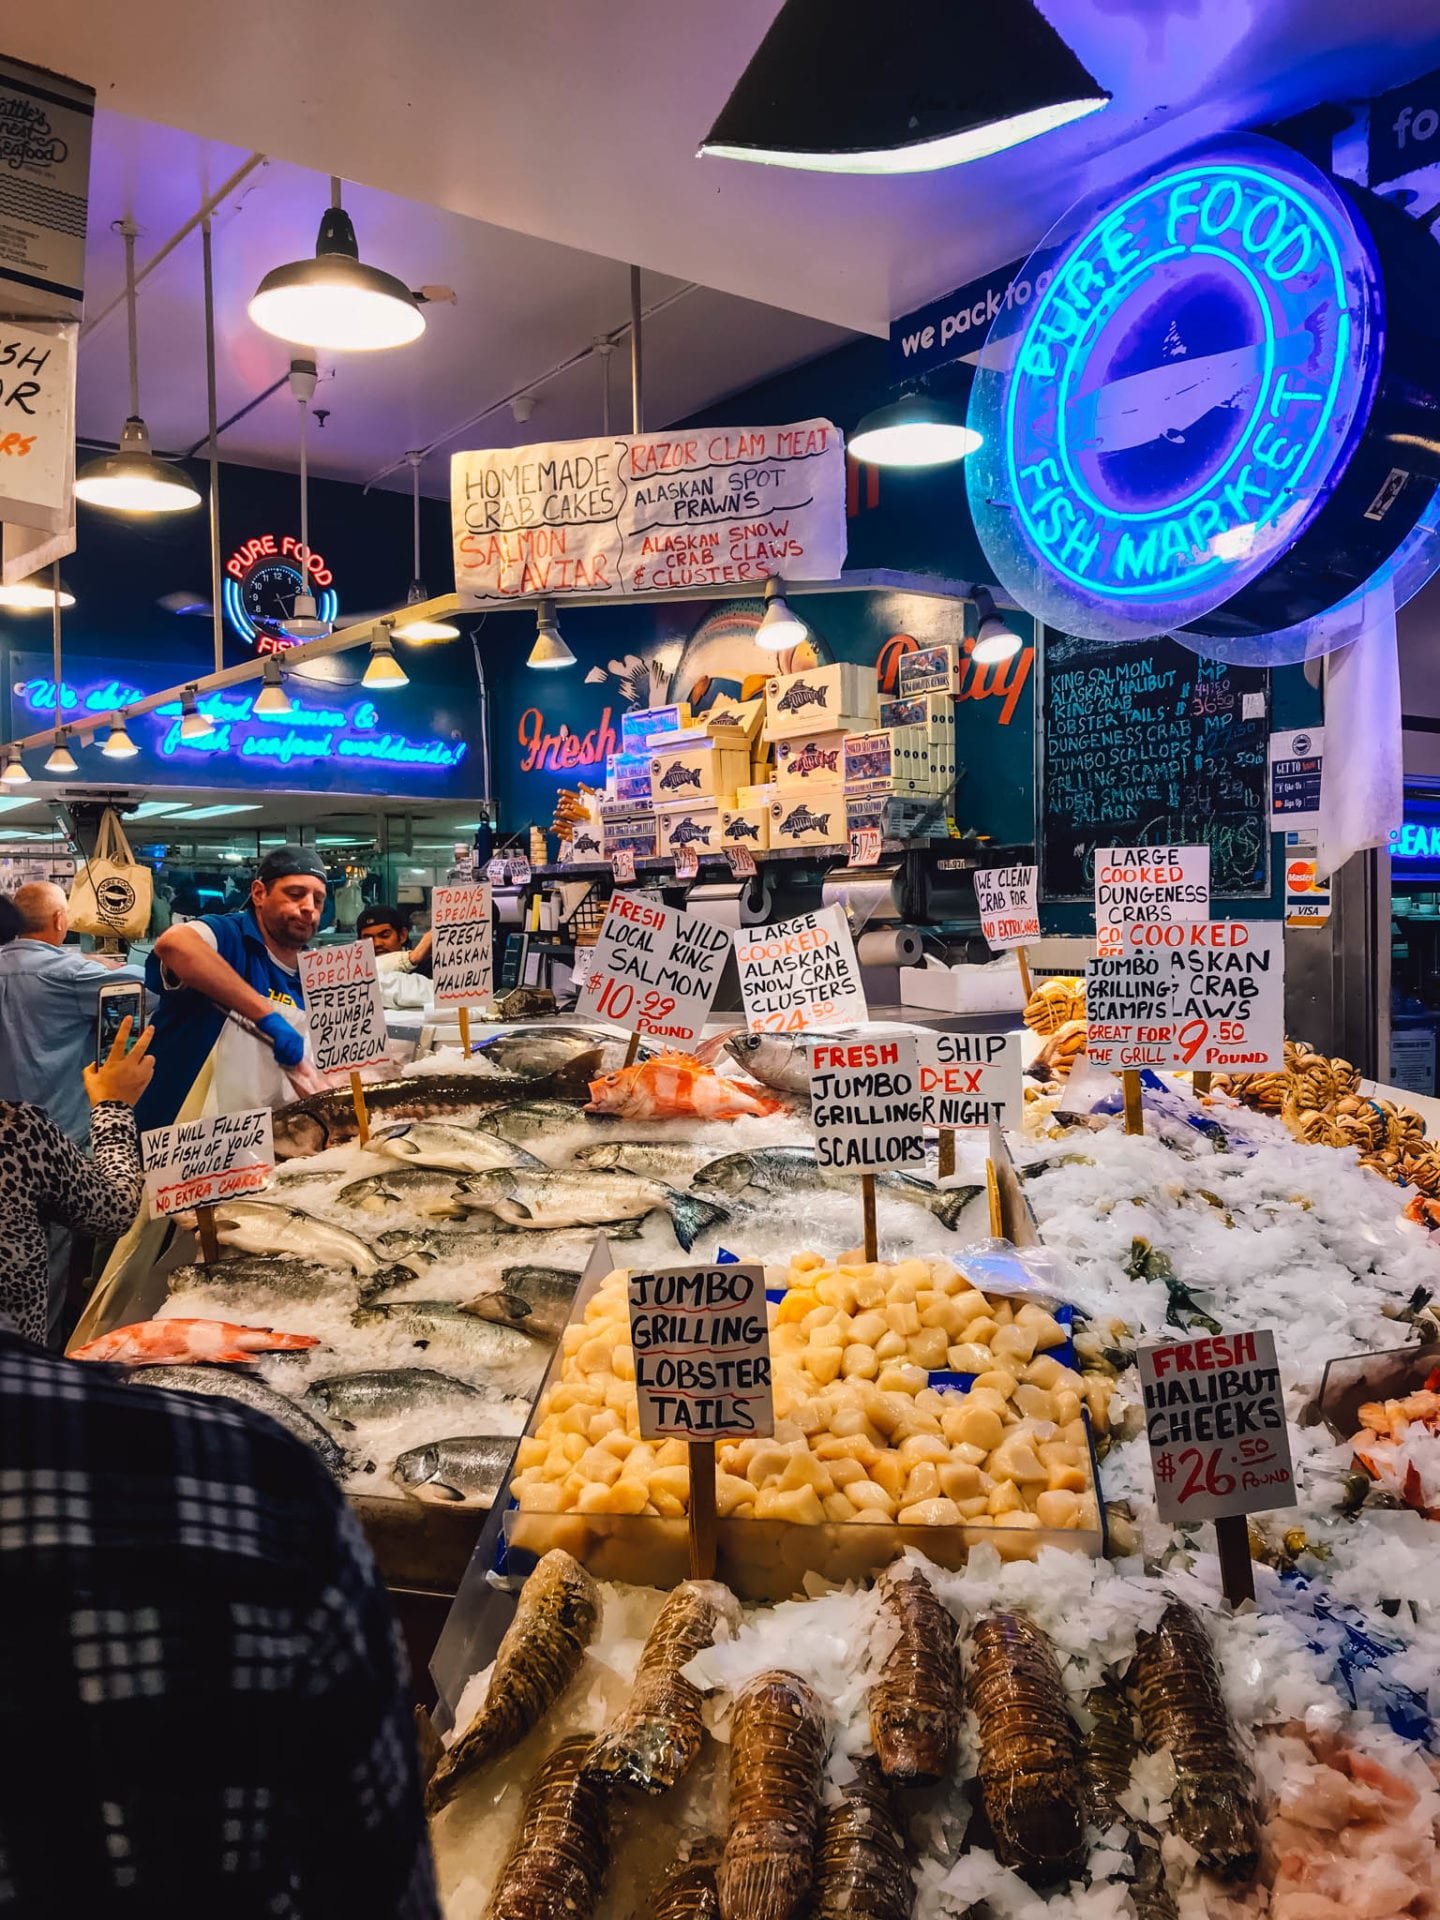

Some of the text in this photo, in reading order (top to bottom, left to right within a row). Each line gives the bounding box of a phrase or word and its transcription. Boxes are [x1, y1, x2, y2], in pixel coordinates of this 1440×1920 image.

[1023, 181, 1312, 377] PURE FOOD
[902, 326, 935, 358] we
[941, 289, 1001, 347] pack
[1005, 281, 1032, 310] to
[630, 427, 829, 475] RAZOR CLAM MEAT
[465, 454, 610, 500] HOMEMADE
[634, 468, 786, 507] ALASKAN SPOT
[1020, 457, 1100, 574] FISH
[1116, 373, 1322, 579] MARKET
[465, 487, 614, 528] CRAB CAKES
[674, 491, 760, 519] PRAWNS
[459, 528, 566, 568] SALMON
[641, 520, 789, 556] ALASKAN SNOW
[226, 535, 333, 586] PURE FOOD
[665, 540, 804, 568] CRAB CLAWS
[497, 553, 611, 595] CAVIAR
[633, 562, 770, 586] & CLUSTERS
[876, 634, 1036, 724] Dily
[1050, 664, 1227, 707] ALASKAN HALIBUT MP
[1051, 657, 1153, 693] KING SALMON
[27, 680, 78, 709] We
[1054, 699, 1094, 721] KING
[1097, 695, 1132, 713] CRAB
[1047, 713, 1118, 737] LOBSTER
[1121, 706, 1165, 724] TAILS
[1049, 713, 1233, 756] DUNGENESS CRAB MP
[242, 730, 333, 764] seafood
[338, 734, 466, 765] worldwide!
[518, 707, 620, 772] Fresh
[1049, 741, 1191, 776] JUMBO SCALLOPS
[1121, 755, 1188, 785] SCAMPI
[1111, 849, 1179, 867] LARGE
[977, 868, 1031, 889] WE CLEAN
[1100, 866, 1184, 884] COOKED
[436, 886, 484, 904] TODAY'S
[980, 890, 1027, 912] CRAB FOR
[1099, 885, 1208, 905] DUNGENESS
[435, 903, 485, 922] SPECIAL
[610, 895, 729, 951] FRESH WILD
[1108, 905, 1172, 924] CRABS
[1298, 906, 1319, 915] VISA
[436, 926, 486, 947] FRESH
[750, 914, 817, 943] LARGE
[984, 922, 995, 938] NO
[1129, 924, 1248, 947] COOKED
[304, 943, 363, 968] TODAY'S
[433, 946, 489, 969] ALASKAN
[605, 919, 714, 972] LOCAL KING
[738, 928, 829, 961] COOKED
[745, 941, 840, 978] ALASKAN
[1089, 958, 1159, 977] JUMBO
[1135, 949, 1270, 974] ASKAN
[306, 961, 373, 988] SPECIAL
[435, 967, 490, 994] HALIBUT
[608, 949, 712, 1000] SALMON
[744, 959, 849, 996] SNOW CRAB
[1190, 975, 1259, 998] CRAB
[309, 988, 370, 1011] FRESH
[752, 977, 856, 1013] CLUSTERS
[1087, 980, 1171, 999] GRILLING
[310, 1000, 374, 1030] COLUMBIA
[1088, 1001, 1167, 1021] SCAMPIS
[1172, 997, 1250, 1020] LAWS
[320, 1018, 371, 1045] RIVER
[636, 1018, 694, 1040] POUND
[1088, 1024, 1171, 1042] GREAT FOR
[316, 1034, 386, 1069] STURGEON
[813, 1042, 899, 1069] FRESH
[937, 1036, 1007, 1063] SHIP
[1088, 1047, 1166, 1064] THE GRILL
[1206, 1048, 1268, 1064] POUND
[812, 1072, 912, 1100] JUMBO
[920, 1068, 983, 1093] D-EX
[814, 1102, 921, 1128] GRILLING
[941, 1099, 1006, 1125] NIGHT
[147, 1112, 266, 1153] WE WILL FILLET
[146, 1130, 265, 1172] THE FISH OF YOUR
[818, 1135, 925, 1167] SCALLOPS
[182, 1155, 234, 1180] CHOICE
[156, 1196, 170, 1213] NO
[175, 1183, 212, 1206] EXTRA
[630, 1272, 754, 1306] JUMBO
[631, 1314, 768, 1349] GRILLING
[1152, 1332, 1257, 1378] FRESH
[637, 1357, 771, 1389] LOBSTER
[1144, 1368, 1280, 1409] HALIBUT
[649, 1396, 754, 1430] TAILS
[1148, 1397, 1281, 1446] CHEEKS
[1242, 1468, 1290, 1491] POUND
